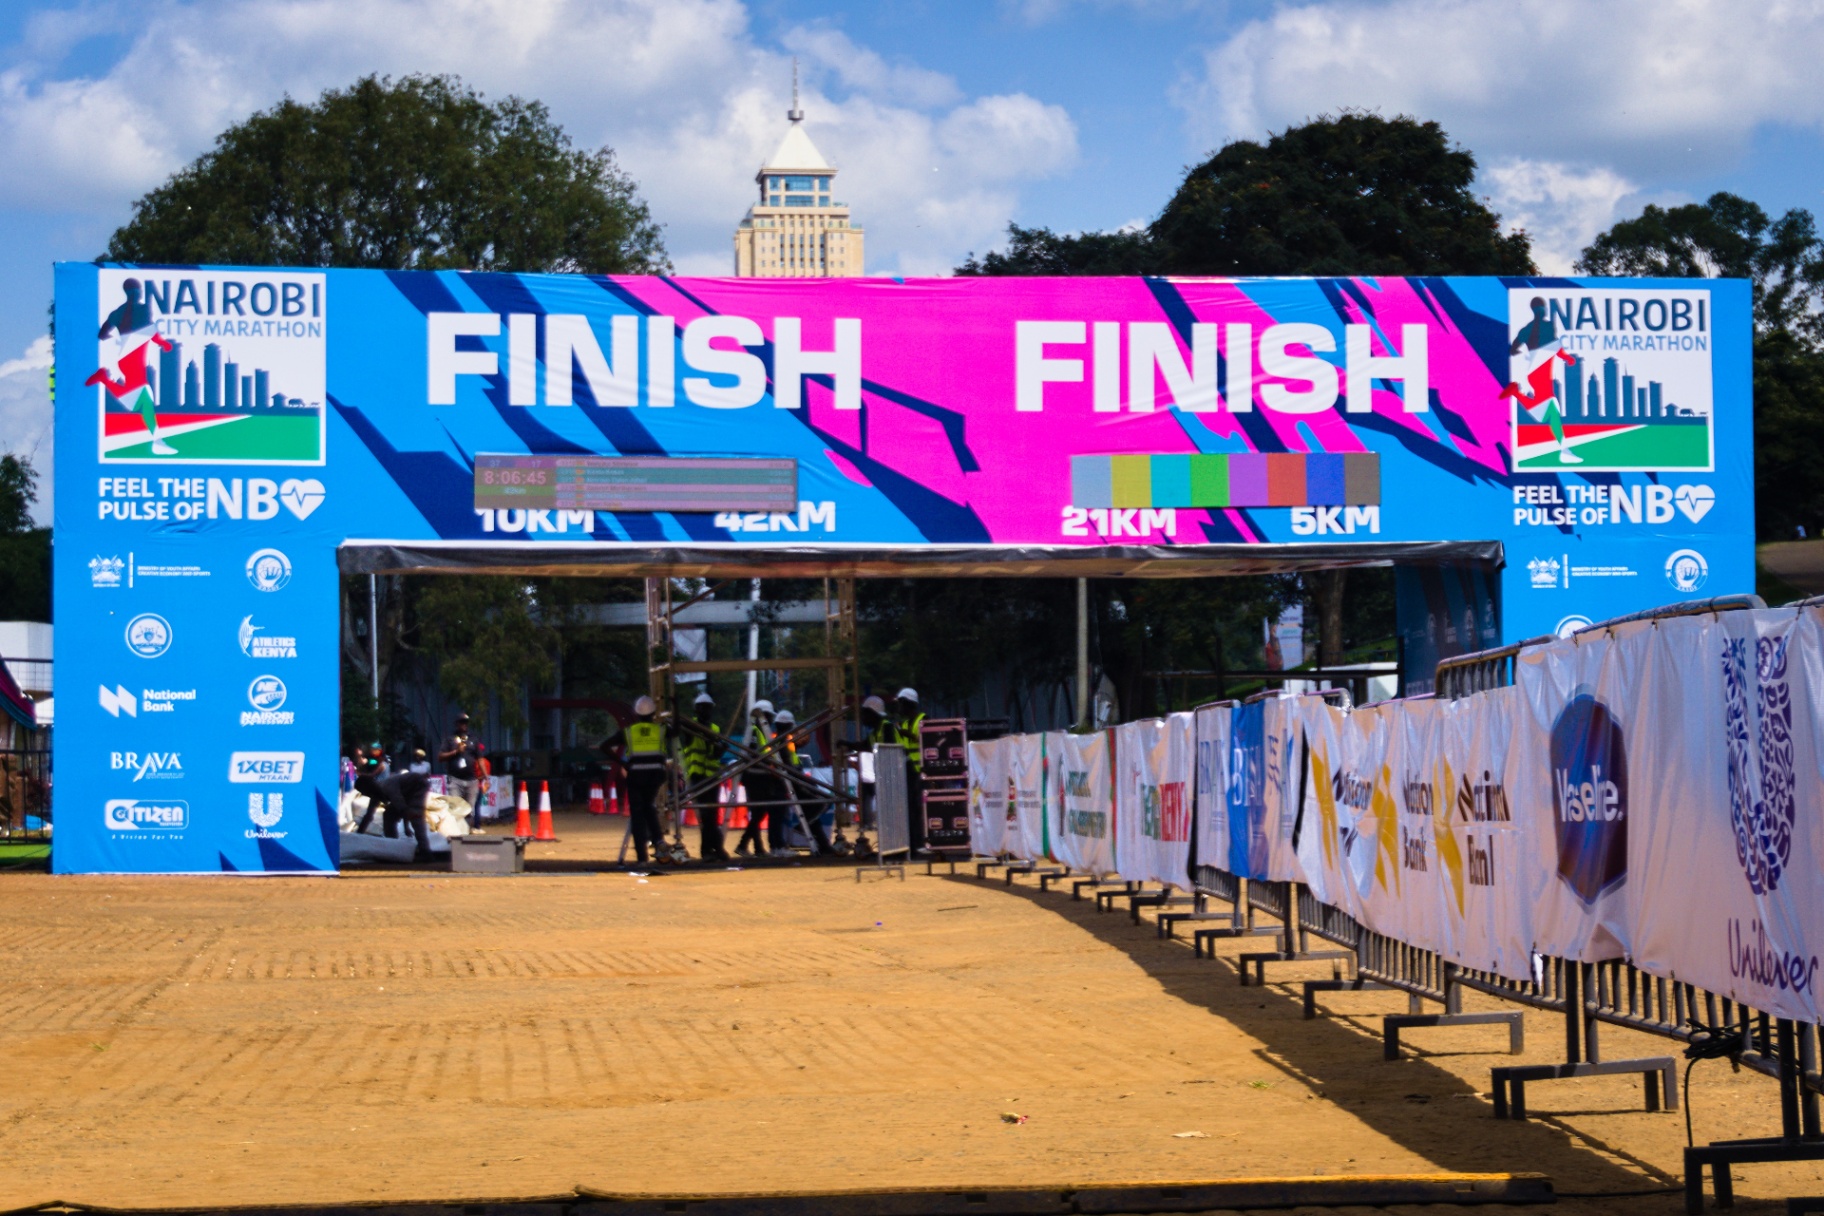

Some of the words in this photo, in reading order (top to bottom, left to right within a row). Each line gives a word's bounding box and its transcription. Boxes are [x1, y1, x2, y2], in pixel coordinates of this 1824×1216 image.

[144, 279, 321, 318] NAIROBI
[1549, 297, 1707, 332] NAIROBI
[154, 318, 200, 336] CITY
[203, 320, 321, 338] MARATHON
[1559, 334, 1600, 351] CITY
[1603, 334, 1708, 351] MARATHON
[428, 312, 862, 410] FINISH
[1016, 320, 1430, 414] FINISH
[98, 477, 154, 498] FEEL
[158, 477, 205, 498] THE
[484, 470, 547, 485] 8:06:45
[1513, 485, 1564, 505] FEEL
[1566, 485, 1609, 505] THE
[98, 501, 169, 520] PULSE
[174, 501, 205, 520] OF
[475, 508, 595, 533] 10KM
[714, 501, 836, 532] 42KM
[1290, 505, 1380, 536] 5KM
[1513, 507, 1577, 526] PULSE
[1581, 507, 1610, 525] OF
[1061, 505, 1177, 537] 21KM
[252, 637, 296, 647] ATHLETICS
[252, 647, 297, 658] KENYA
[142, 689, 196, 700] National
[142, 700, 174, 712] Bank
[240, 711, 295, 720] NAIROBI
[110, 751, 183, 782] BRAVA
[237, 760, 299, 774] 1XBET
[244, 829, 289, 839] Unilever
[1728, 917, 1819, 996] Unilever
